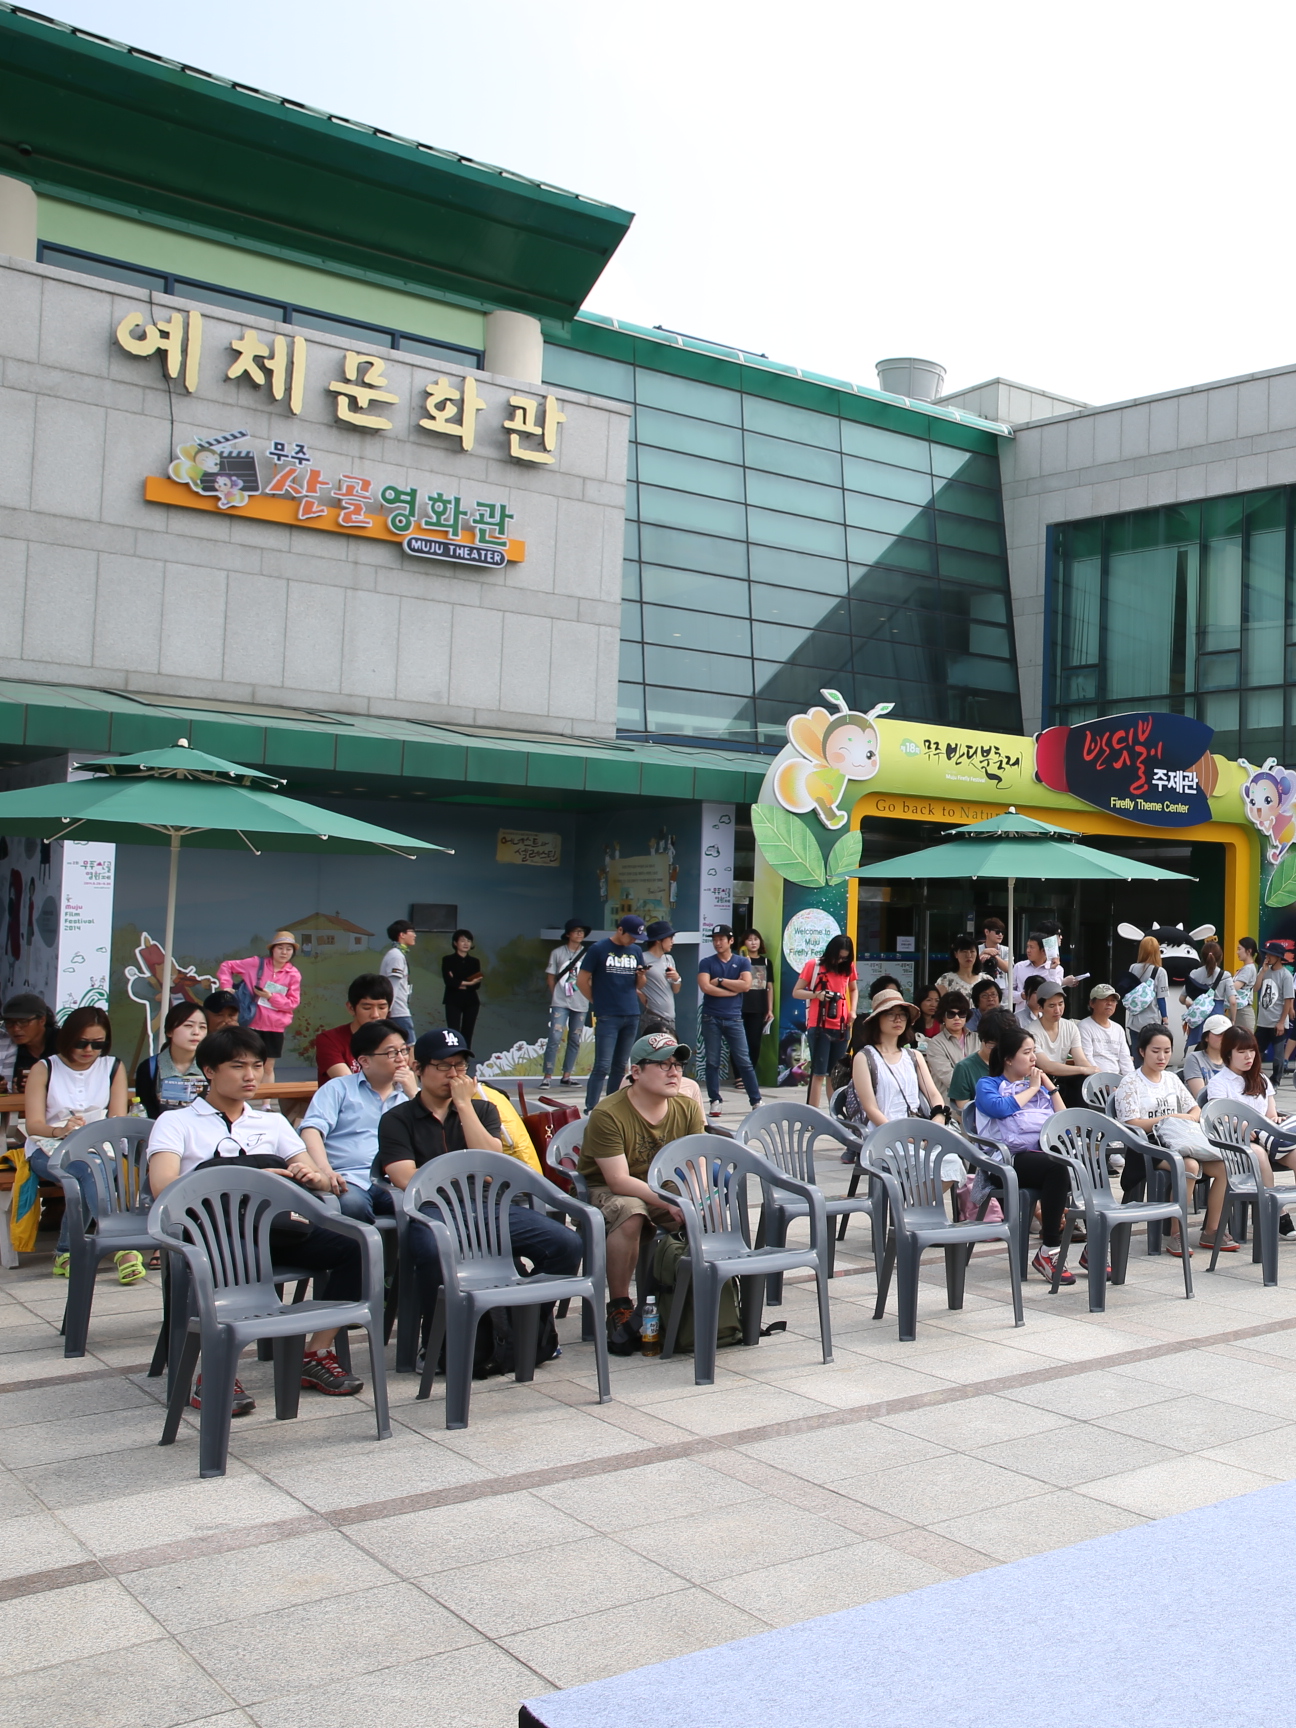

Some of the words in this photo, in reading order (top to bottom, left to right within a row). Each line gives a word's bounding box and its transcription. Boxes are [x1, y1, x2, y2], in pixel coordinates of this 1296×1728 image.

[116, 310, 567, 465] 예체문화관
[267, 439, 312, 467] 무주
[411, 538, 444, 557] MUJU
[447, 543, 504, 565] THEATER
[971, 775, 986, 783] Festival
[1152, 768, 1199, 794] 주제관
[875, 798, 896, 812] Go
[902, 801, 935, 816] back
[942, 805, 955, 817] to
[1110, 797, 1135, 811] Firefly
[1136, 798, 1162, 812] Theme
[1164, 801, 1189, 813] Center
[794, 927, 823, 935] Welcome
[805, 938, 820, 947] Muju
[789, 949, 809, 957] Firefly
[606, 955, 637, 969] ALIEN
[442, 1030, 459, 1046] LA
